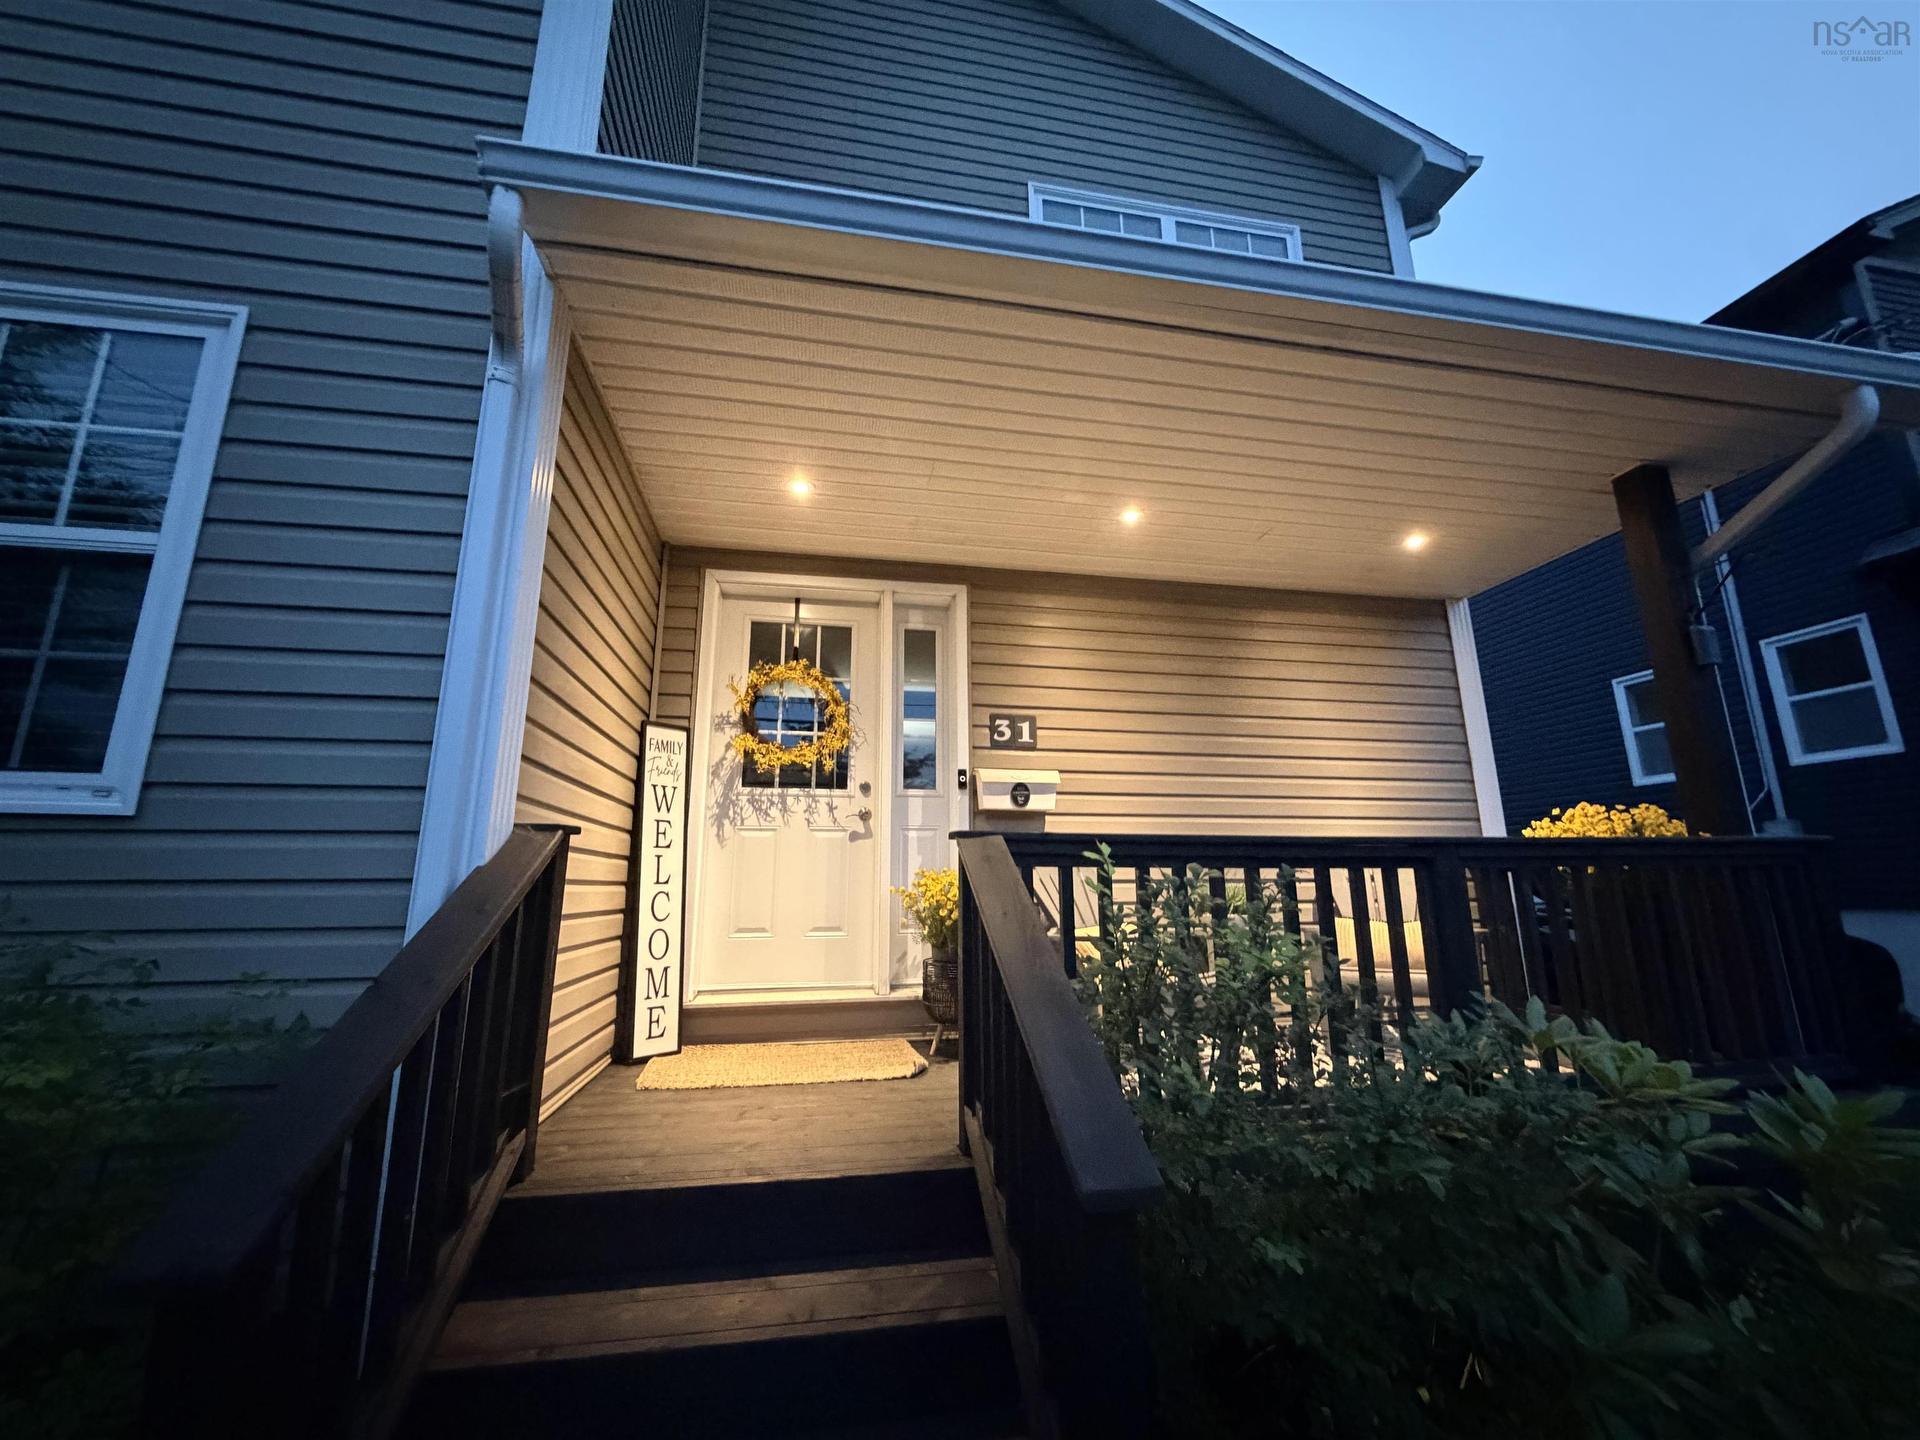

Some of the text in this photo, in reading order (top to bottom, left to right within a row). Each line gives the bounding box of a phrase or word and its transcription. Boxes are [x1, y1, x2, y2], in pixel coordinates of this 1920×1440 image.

[993, 718, 1034, 743] 31
[648, 737, 684, 756] FAMILY
[647, 756, 683, 783] Friends
[666, 755, 674, 768] &
[644, 783, 678, 1041] WELCOME
